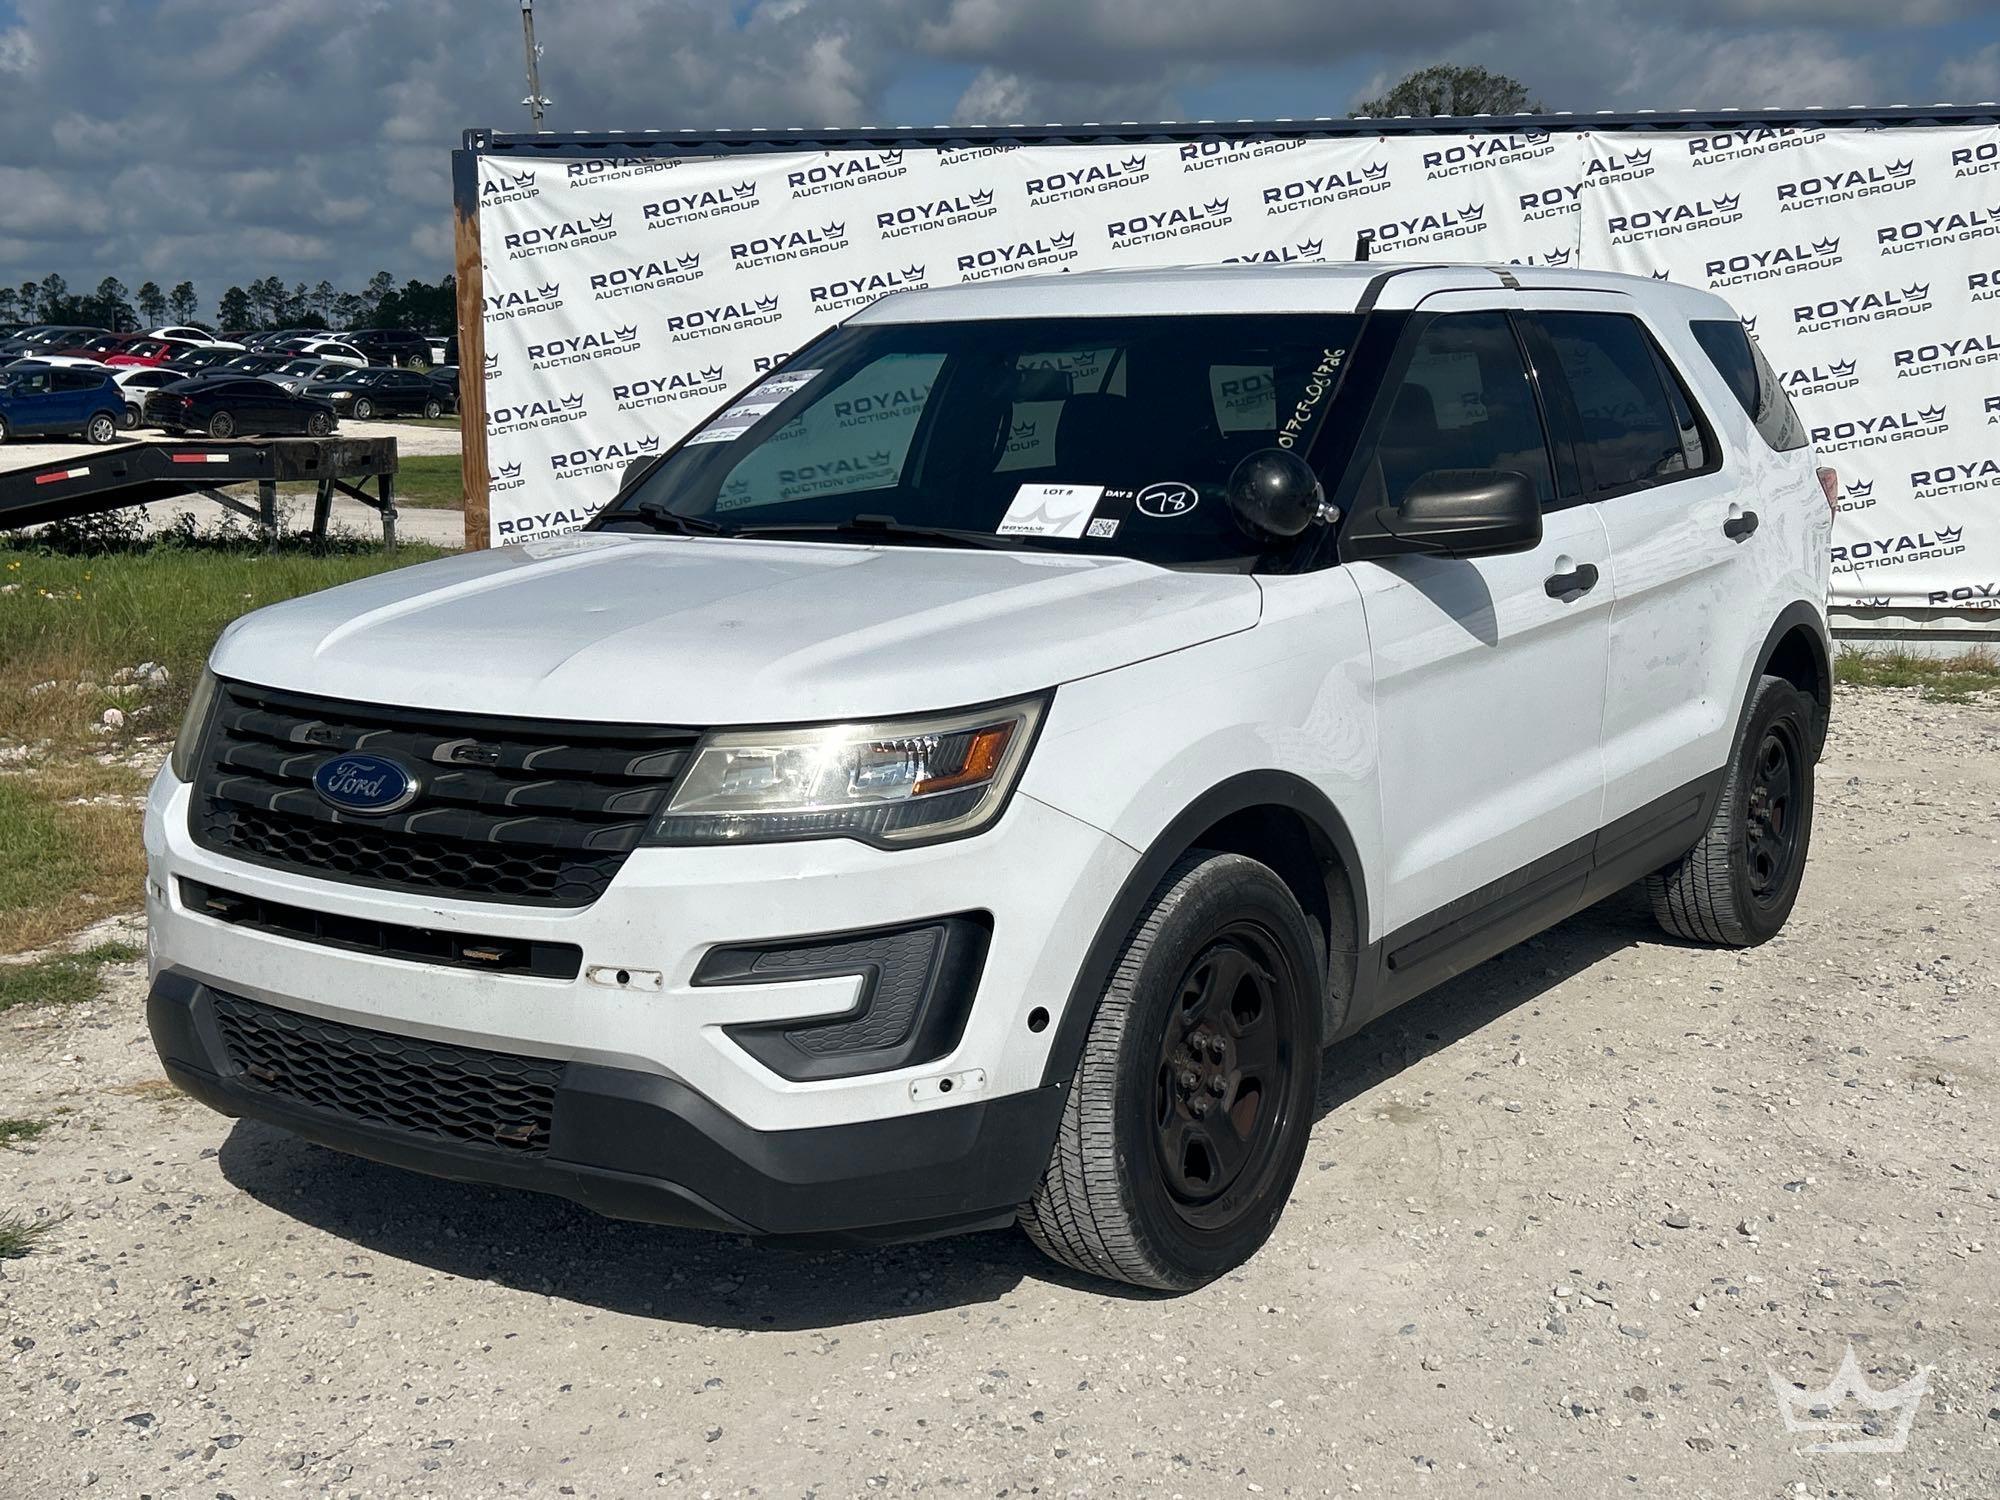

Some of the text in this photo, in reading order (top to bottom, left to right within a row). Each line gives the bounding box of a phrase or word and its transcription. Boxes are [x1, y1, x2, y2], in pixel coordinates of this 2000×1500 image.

[940, 146, 1004, 166] AUCTION
[1184, 138, 1307, 173] AUCTION GROUP
[1423, 136, 1526, 169] ROYAL
[1427, 147, 1554, 180] AUCTION GROUP
[1692, 133, 1826, 167] AUCTION GROUP
[570, 159, 682, 189] AUCTION GROUP
[788, 154, 882, 187] ROYAL
[793, 168, 906, 199] AUCTION GROUP
[1026, 164, 1121, 195] ROYAL
[1599, 168, 1655, 186] GROUP
[1777, 168, 1885, 200] ROYAL
[494, 189, 540, 205] GROUP
[1031, 174, 1149, 207] AUCTION GROUP
[1263, 171, 1362, 204] ROYAL
[1267, 182, 1390, 215] AUCTION GROUP
[1781, 179, 1915, 212] AUCTION GROUP
[643, 187, 735, 219] ROYAL
[648, 200, 759, 230] AUCTION GROUP
[877, 195, 972, 228] ROYAL
[1523, 203, 1582, 222] AUCTIO
[1609, 202, 1712, 233] ROYAL
[505, 218, 593, 249] ROYAL
[882, 208, 997, 239] AUCTION GROUP
[1108, 206, 1204, 238] ROYAL
[1112, 217, 1232, 249] AUCTION GROUP
[1433, 223, 1487, 241] GROUP
[1612, 213, 1742, 245] AUCTION GROUP
[1877, 211, 1987, 244] ROYAL
[510, 231, 617, 260] AUCTION GROUP
[731, 227, 824, 259] ROYAL
[736, 240, 848, 270] AUCTION GROUP
[958, 240, 1051, 271] ROYAL
[1881, 235, 1955, 256] AUCTION
[591, 258, 680, 289] ROYAL
[962, 251, 1078, 282] AUCTION GROUP
[1706, 245, 1811, 277] ROYAL
[1710, 256, 1842, 289] AUCTION GROUP
[595, 271, 703, 300] AUCTION GROUP
[810, 272, 902, 302] ROYAL
[517, 300, 563, 316] GROUP
[667, 303, 755, 331] ROYAL
[815, 294, 876, 313] AUCTION
[1794, 291, 1901, 322] ROYAL
[1798, 302, 1932, 334] AUCTION GROUP
[672, 314, 782, 342] AUCTION GROUP
[528, 330, 617, 360] ROYAL
[533, 343, 640, 370] AUCTION GROUP
[1897, 358, 1971, 379] AUCTION
[613, 373, 701, 400] ROYAL
[618, 384, 726, 411] AUCTION GROUP
[1802, 378, 1859, 396] GROUP
[835, 387, 924, 418] ROYAL
[488, 411, 587, 436] UCTION GROUP
[839, 410, 899, 428] AUCTION
[1811, 413, 1918, 443] ROYAL
[1816, 424, 1948, 453] AUCTION GROUP
[551, 441, 640, 469] ROYAL
[556, 463, 613, 480] AUCTION
[778, 457, 866, 484] ROYAL
[1043, 488, 1066, 496] LOT
[1105, 489, 1125, 498] DAY
[1145, 491, 1187, 512] 78
[1914, 480, 1988, 500] AUCTION
[498, 509, 584, 535] ROYAL
[502, 529, 560, 547] AUCTION
[1831, 533, 1935, 562] ROYAL
[1832, 545, 1965, 574] AUCTION GROUP
[328, 761, 387, 797] Ford
